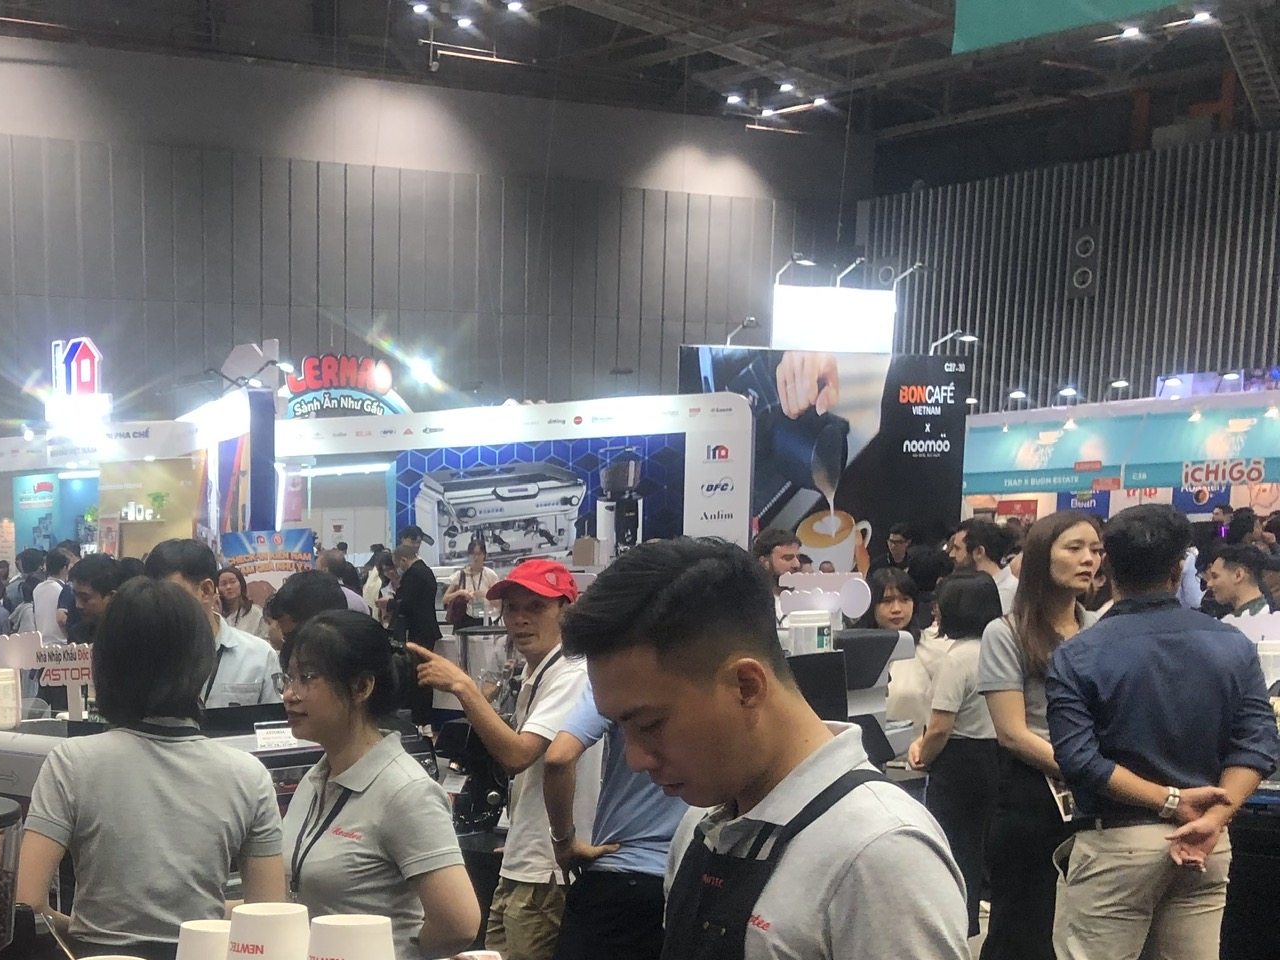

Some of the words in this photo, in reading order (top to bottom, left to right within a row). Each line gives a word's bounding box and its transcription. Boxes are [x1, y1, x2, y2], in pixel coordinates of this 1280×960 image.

[899, 382, 955, 404] BONCAFÉ
[912, 405, 942, 416] VIETNAM
[42, 667, 91, 682] ASTOR
